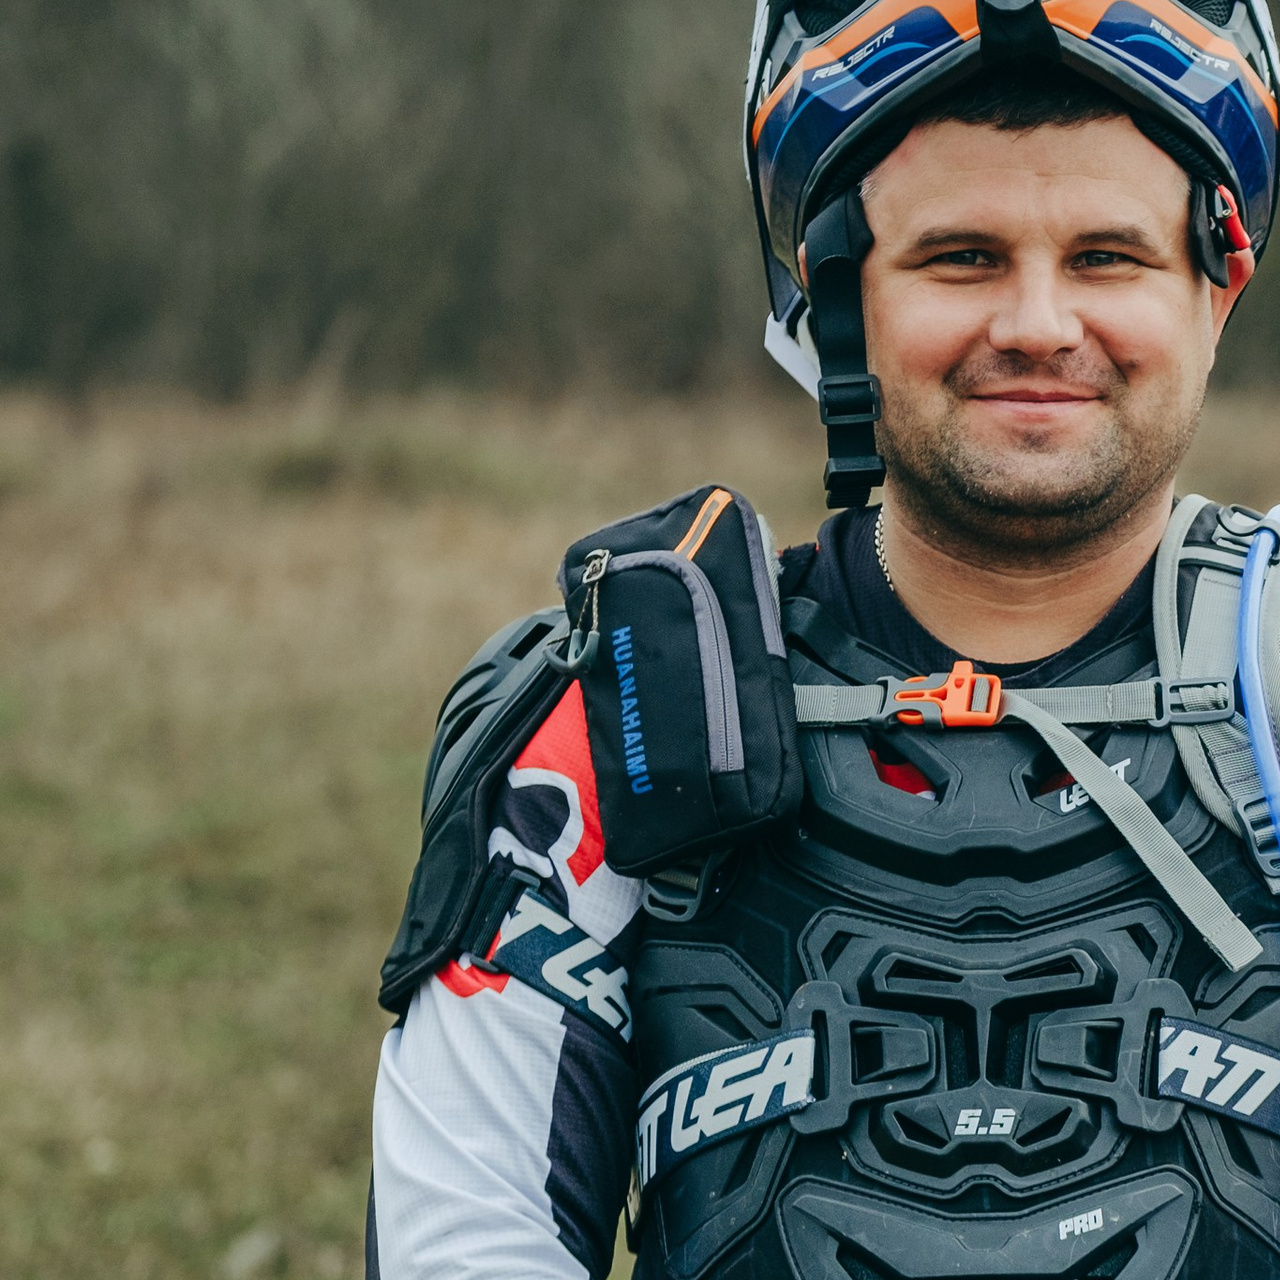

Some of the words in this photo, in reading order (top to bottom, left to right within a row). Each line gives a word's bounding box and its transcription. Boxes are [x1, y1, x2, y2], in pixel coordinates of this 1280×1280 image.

[612, 625, 653, 795] HUANAHAIMU
[954, 1108, 1016, 1136] 5.5
[1058, 1208, 1104, 1241] PRO
